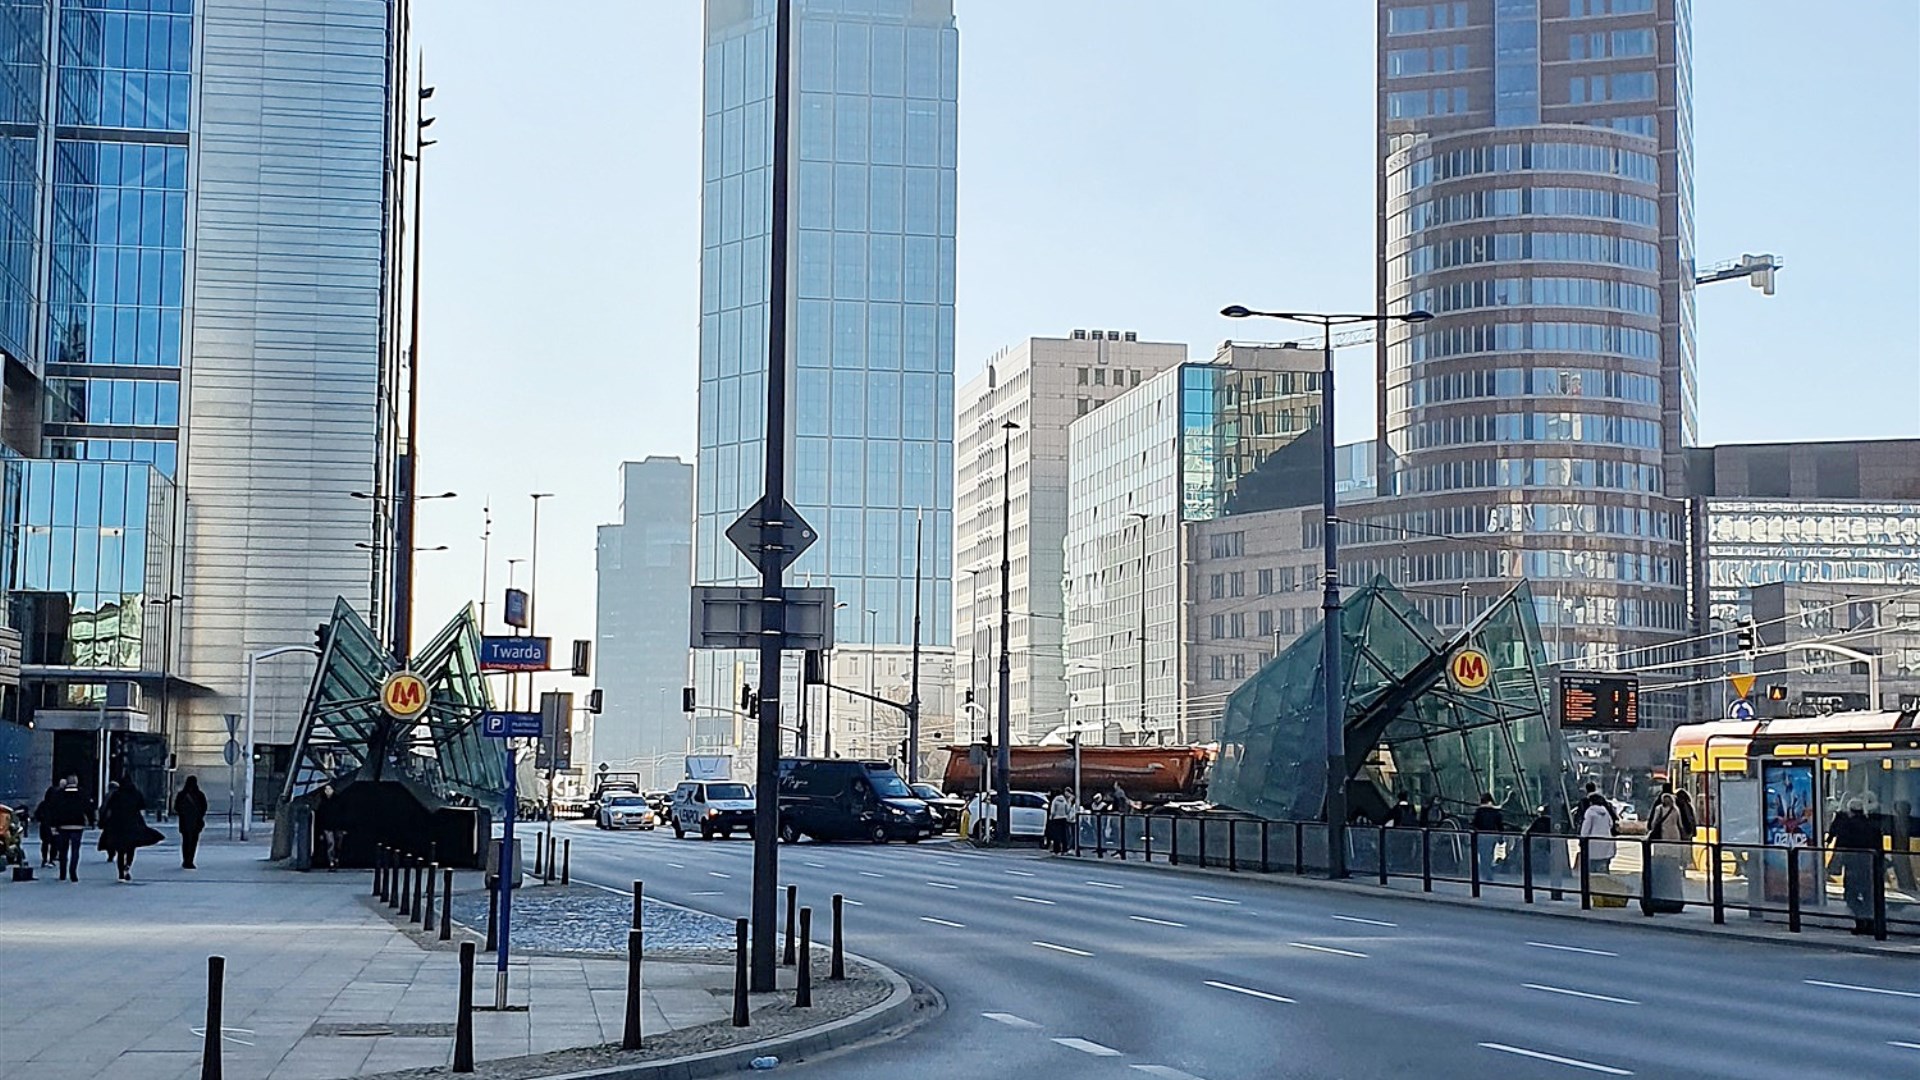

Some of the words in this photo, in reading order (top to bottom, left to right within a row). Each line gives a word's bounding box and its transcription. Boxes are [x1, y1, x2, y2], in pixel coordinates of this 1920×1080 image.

[492, 644, 541, 659] Twarda
[1459, 656, 1485, 681] M
[391, 681, 420, 707] M
[491, 719, 501, 730] P
